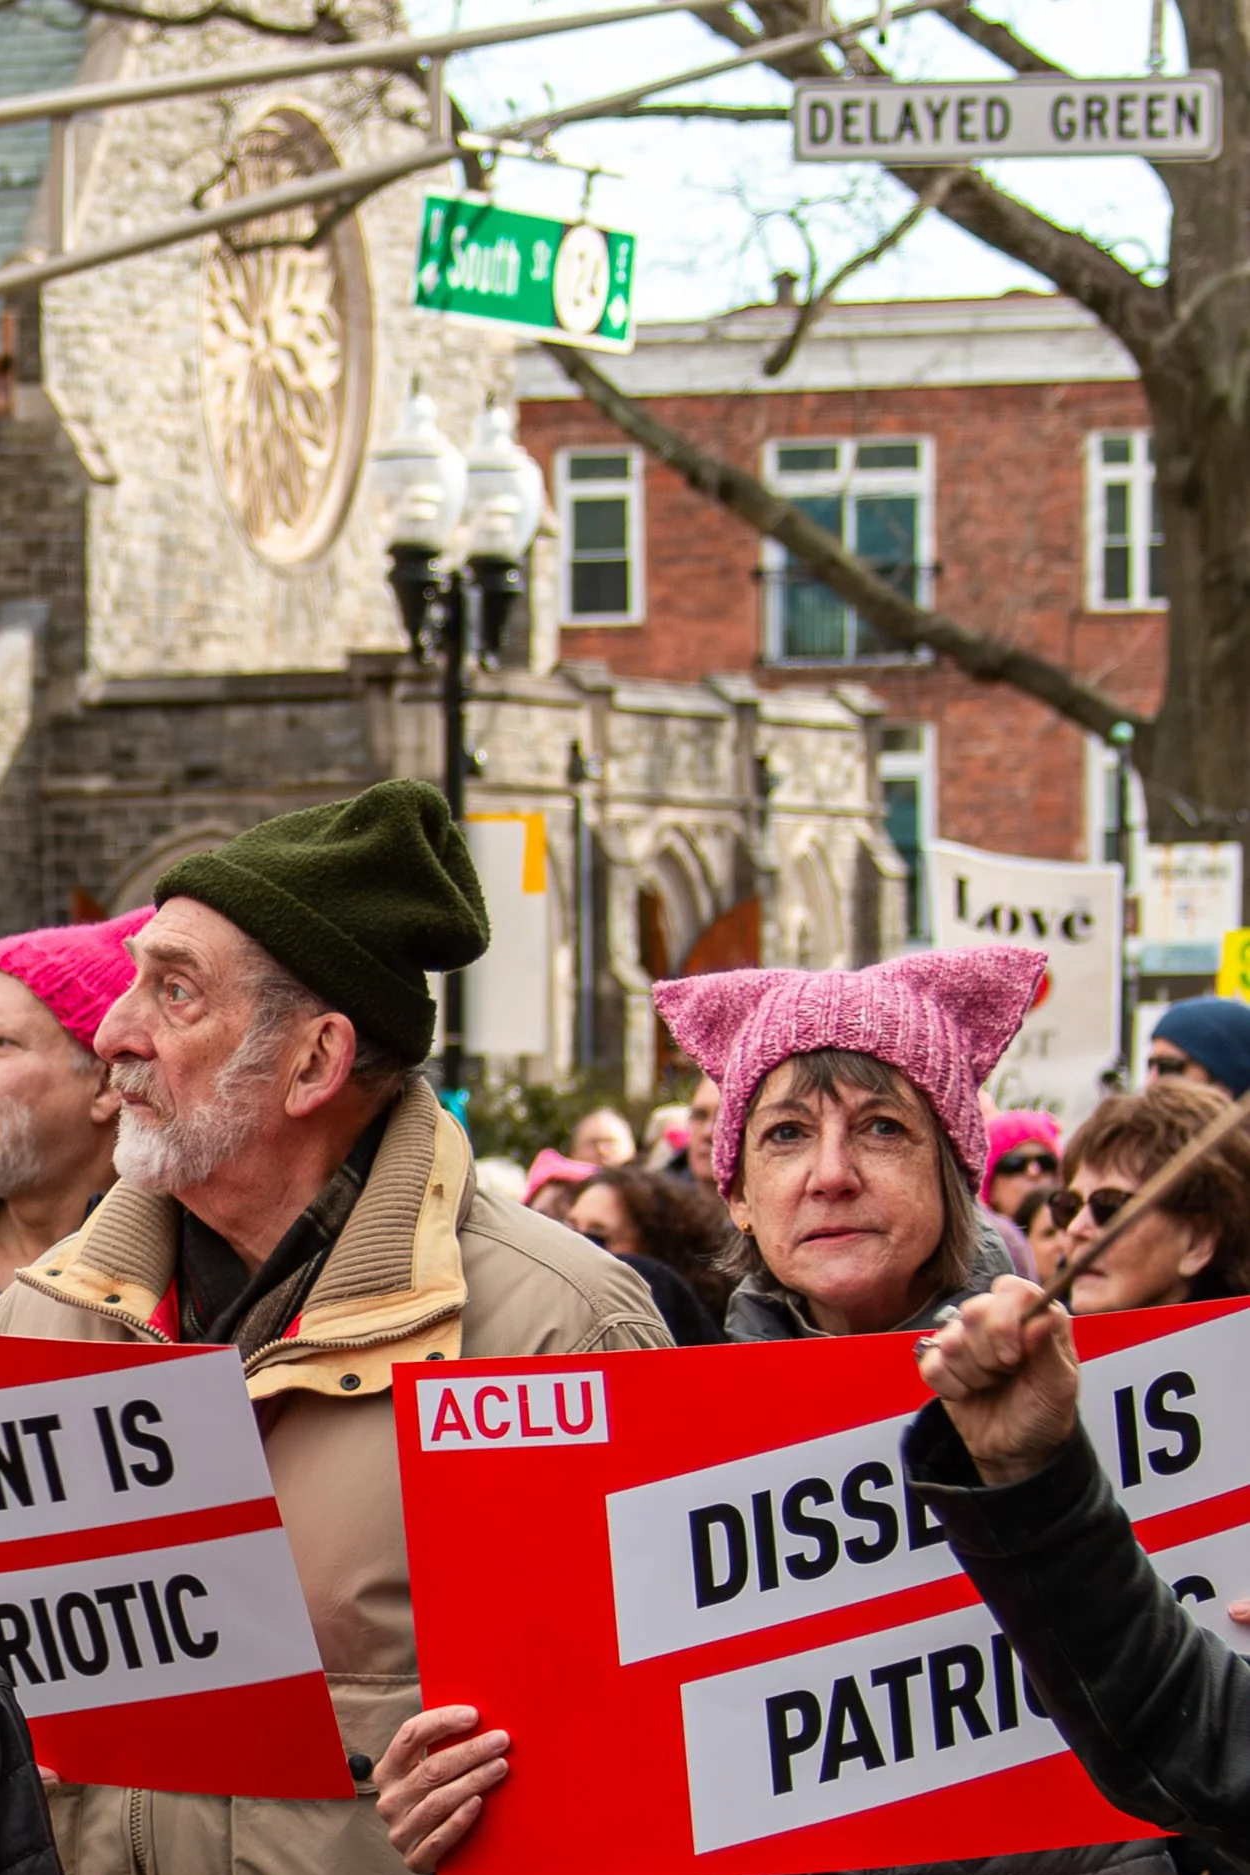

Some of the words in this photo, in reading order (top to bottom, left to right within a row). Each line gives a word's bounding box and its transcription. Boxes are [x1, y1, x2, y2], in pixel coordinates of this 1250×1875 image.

[808, 97, 1011, 145] DELAYED
[1050, 92, 1202, 140] GREEN
[446, 224, 521, 299] South
[954, 874, 1094, 943] Love
[93, 1399, 174, 1492] IS
[430, 1380, 595, 1443] ACLU
[1114, 1370, 1202, 1489] IS
